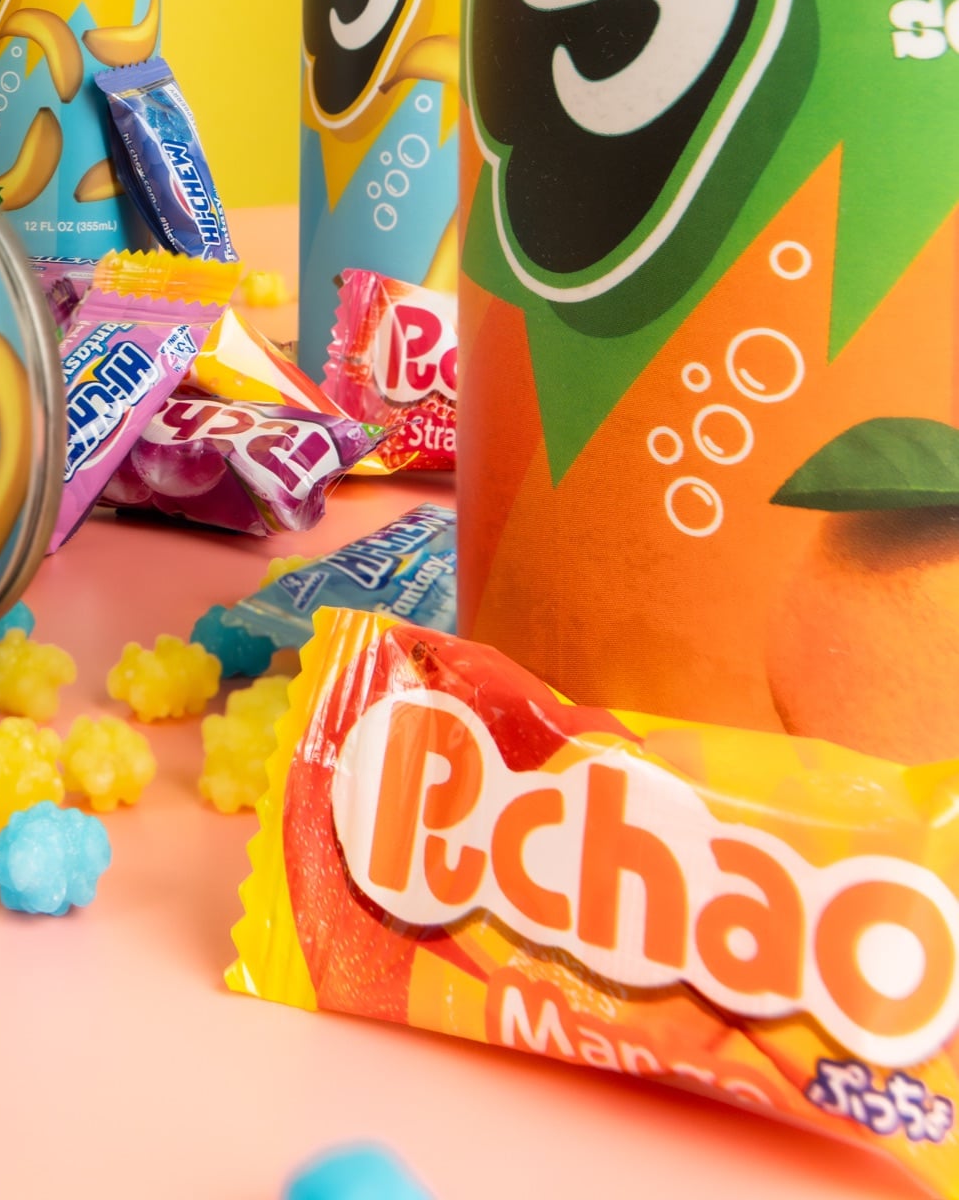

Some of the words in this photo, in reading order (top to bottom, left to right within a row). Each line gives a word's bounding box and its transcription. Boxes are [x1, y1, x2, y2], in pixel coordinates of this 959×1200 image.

[162, 142, 222, 246] HI-CHEW
[24, 221, 38, 232] 12
[40, 221, 55, 232] FL
[57, 221, 75, 232] OZ
[76, 220, 118, 234] (355mL)
